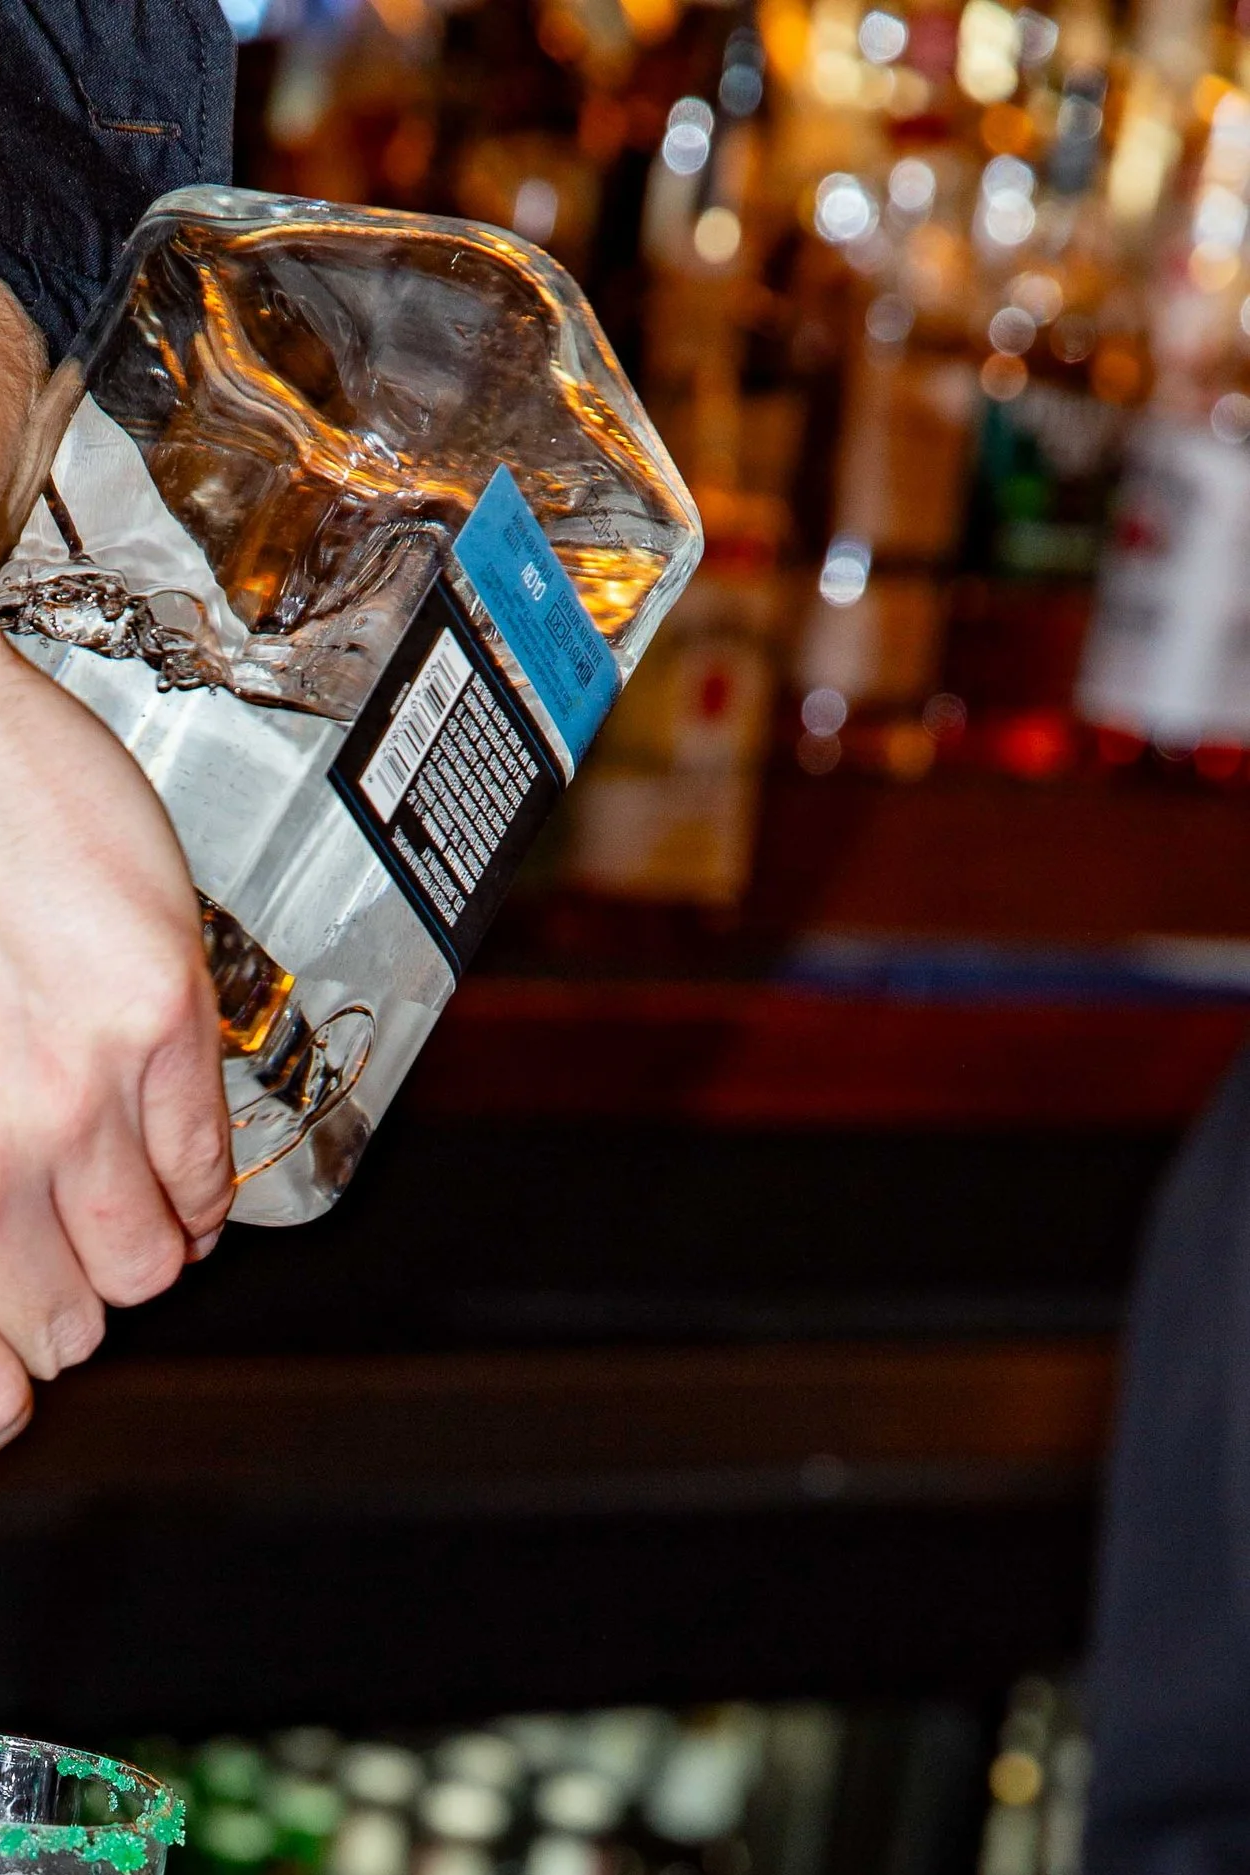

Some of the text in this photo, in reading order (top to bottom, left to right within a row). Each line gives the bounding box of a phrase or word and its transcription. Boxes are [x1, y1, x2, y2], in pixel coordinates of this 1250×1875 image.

[519, 556, 540, 592] CRV
[530, 574, 547, 604] CA
[546, 605, 567, 643] CRT
[556, 588, 603, 668] MADE IN MEXICO
[574, 654, 594, 689] NOM
[490, 703, 510, 736] HEALTH
[483, 718, 504, 754] OPERATE
[505, 726, 522, 755] CAUSE
[452, 752, 470, 782] BIRTH
[453, 699, 523, 810] ERAGES IMPAIRS YOUR ABILITY TO
[498, 742, 510, 763] OR
[504, 751, 517, 774] CAR
[516, 744, 531, 769] MAY
[444, 712, 516, 824] (2) CONSUMPTION OF ALCOHOLIC BEV-
[463, 769, 475, 790] OF
[511, 763, 521, 779] A
[514, 768, 531, 796] DRIVE
[525, 758, 539, 782] AND
[428, 742, 499, 853] BEVERAGES DURING PREGNANCY BE-
[468, 778, 484, 803] RISK
[477, 791, 491, 815] THE
[421, 757, 492, 867] WOMEN SHOULD NOT DRINK ALCOHOLIC
[431, 798, 454, 836] SURGEON
[484, 803, 496, 822] OF
[489, 810, 507, 840] CAUSE
[419, 807, 448, 852] WARNING:
[449, 826, 462, 848] THE
[420, 843, 432, 864] KY
[456, 838, 468, 857] TO
[408, 851, 433, 891] PREMIUM
[442, 842, 476, 895] GOVERNMENT
[462, 846, 484, 881] CORDING
[426, 879, 439, 899] BY
[432, 887, 458, 928] IMPORTED
